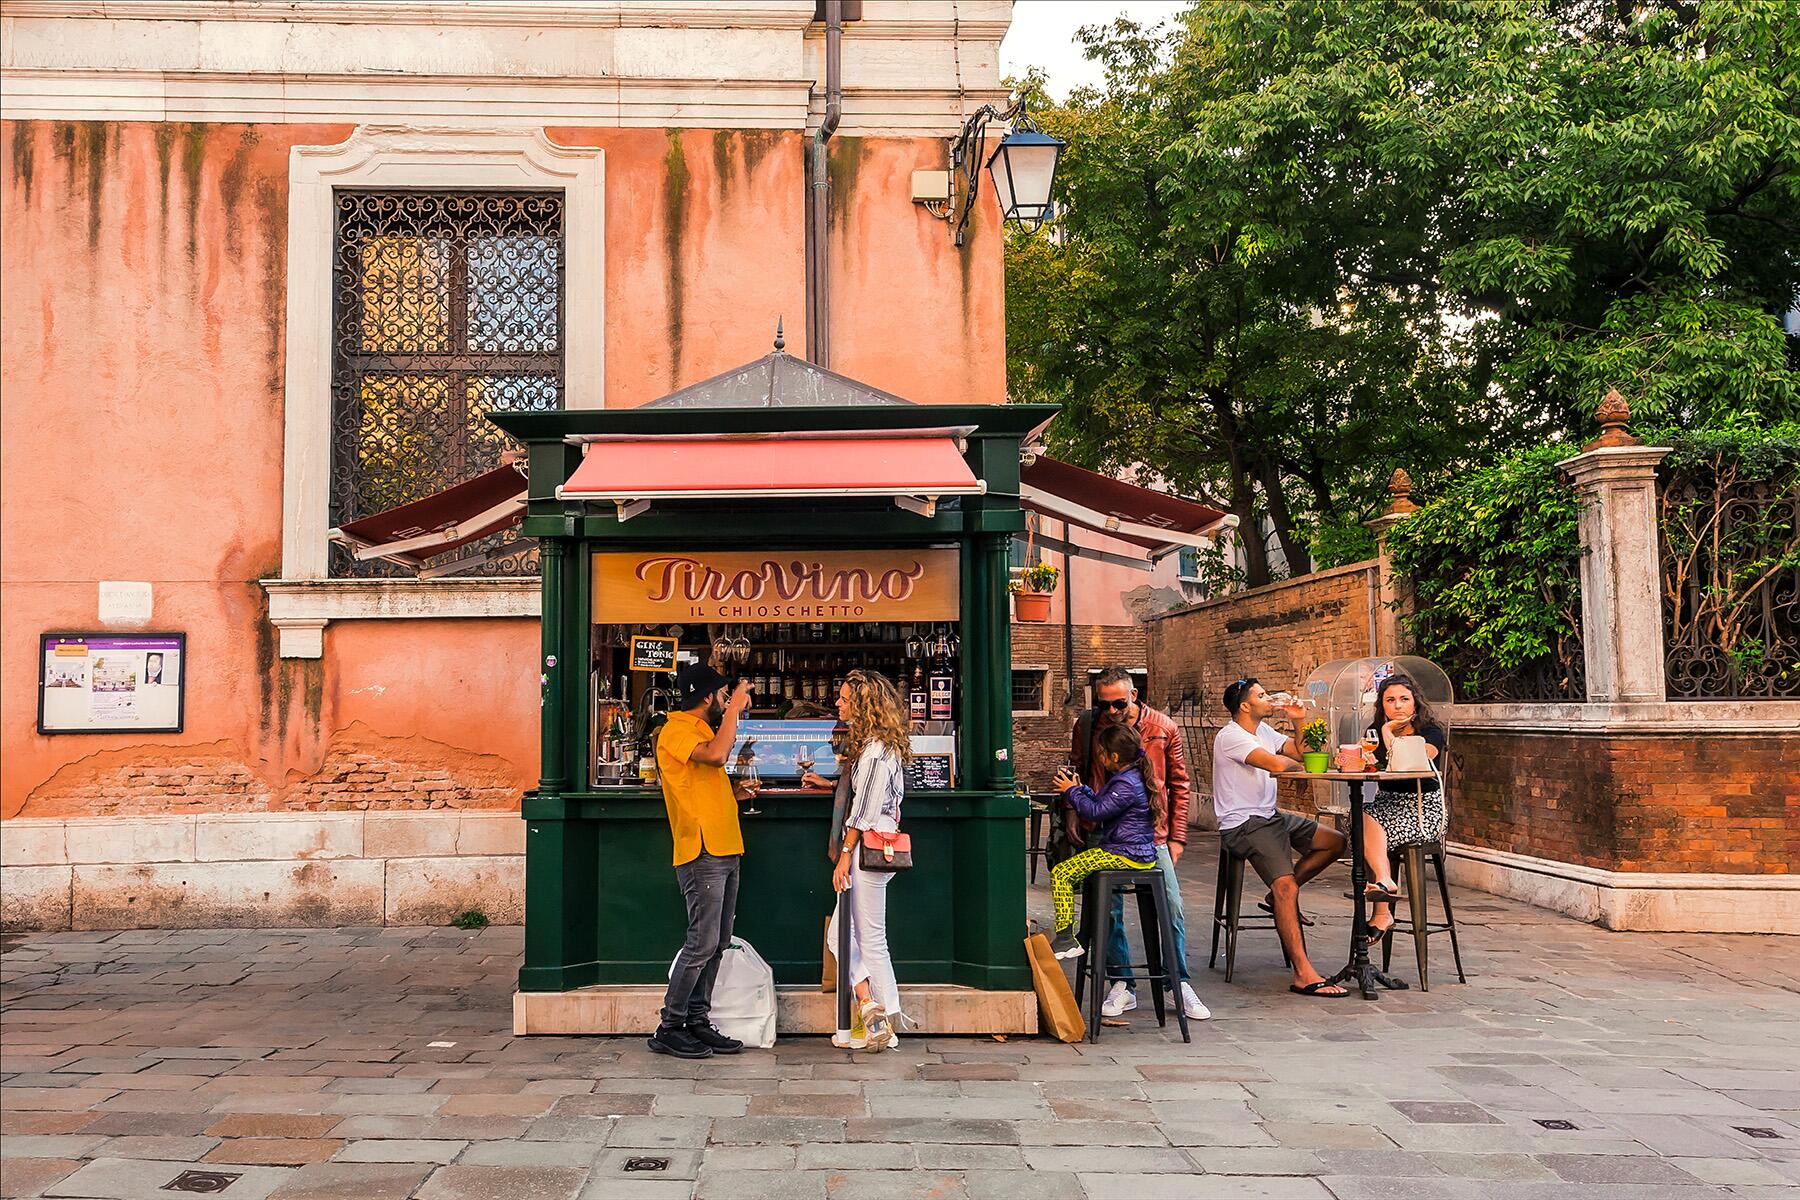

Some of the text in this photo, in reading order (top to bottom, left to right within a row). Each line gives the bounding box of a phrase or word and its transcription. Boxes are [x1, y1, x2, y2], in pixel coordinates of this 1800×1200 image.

[635, 557, 924, 602] TiroVino
[690, 605, 864, 617] IL CHIOSCHETTO
[636, 641, 656, 649] GIN
[646, 650, 674, 659] TONIC
